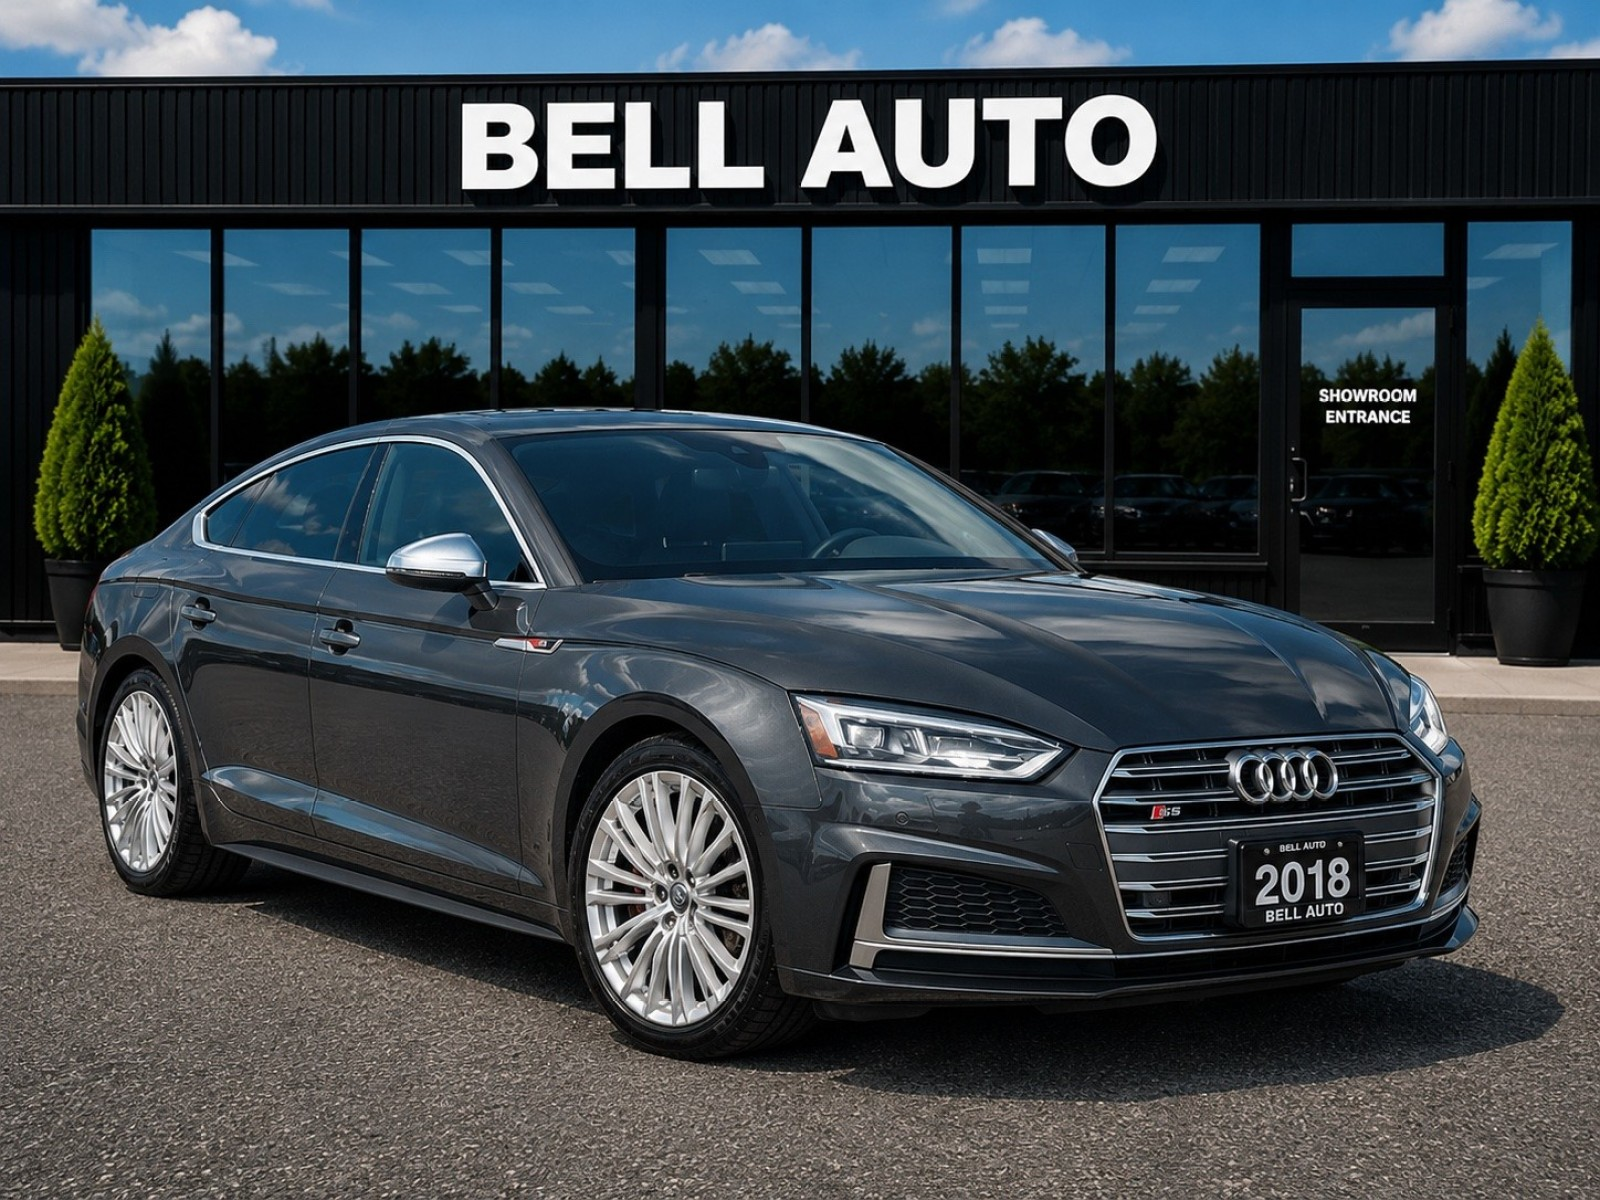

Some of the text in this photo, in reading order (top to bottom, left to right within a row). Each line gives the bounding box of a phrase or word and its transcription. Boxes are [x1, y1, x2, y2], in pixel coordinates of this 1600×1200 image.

[462, 95, 1157, 190] BELL AUTO
[1319, 388, 1417, 402] SHOWROOM
[1325, 410, 1411, 424] ENTRANCE
[1280, 841, 1326, 853] BELL AUTO
[1255, 857, 1351, 906] 2018
[1265, 902, 1344, 923] BELL AUTO
